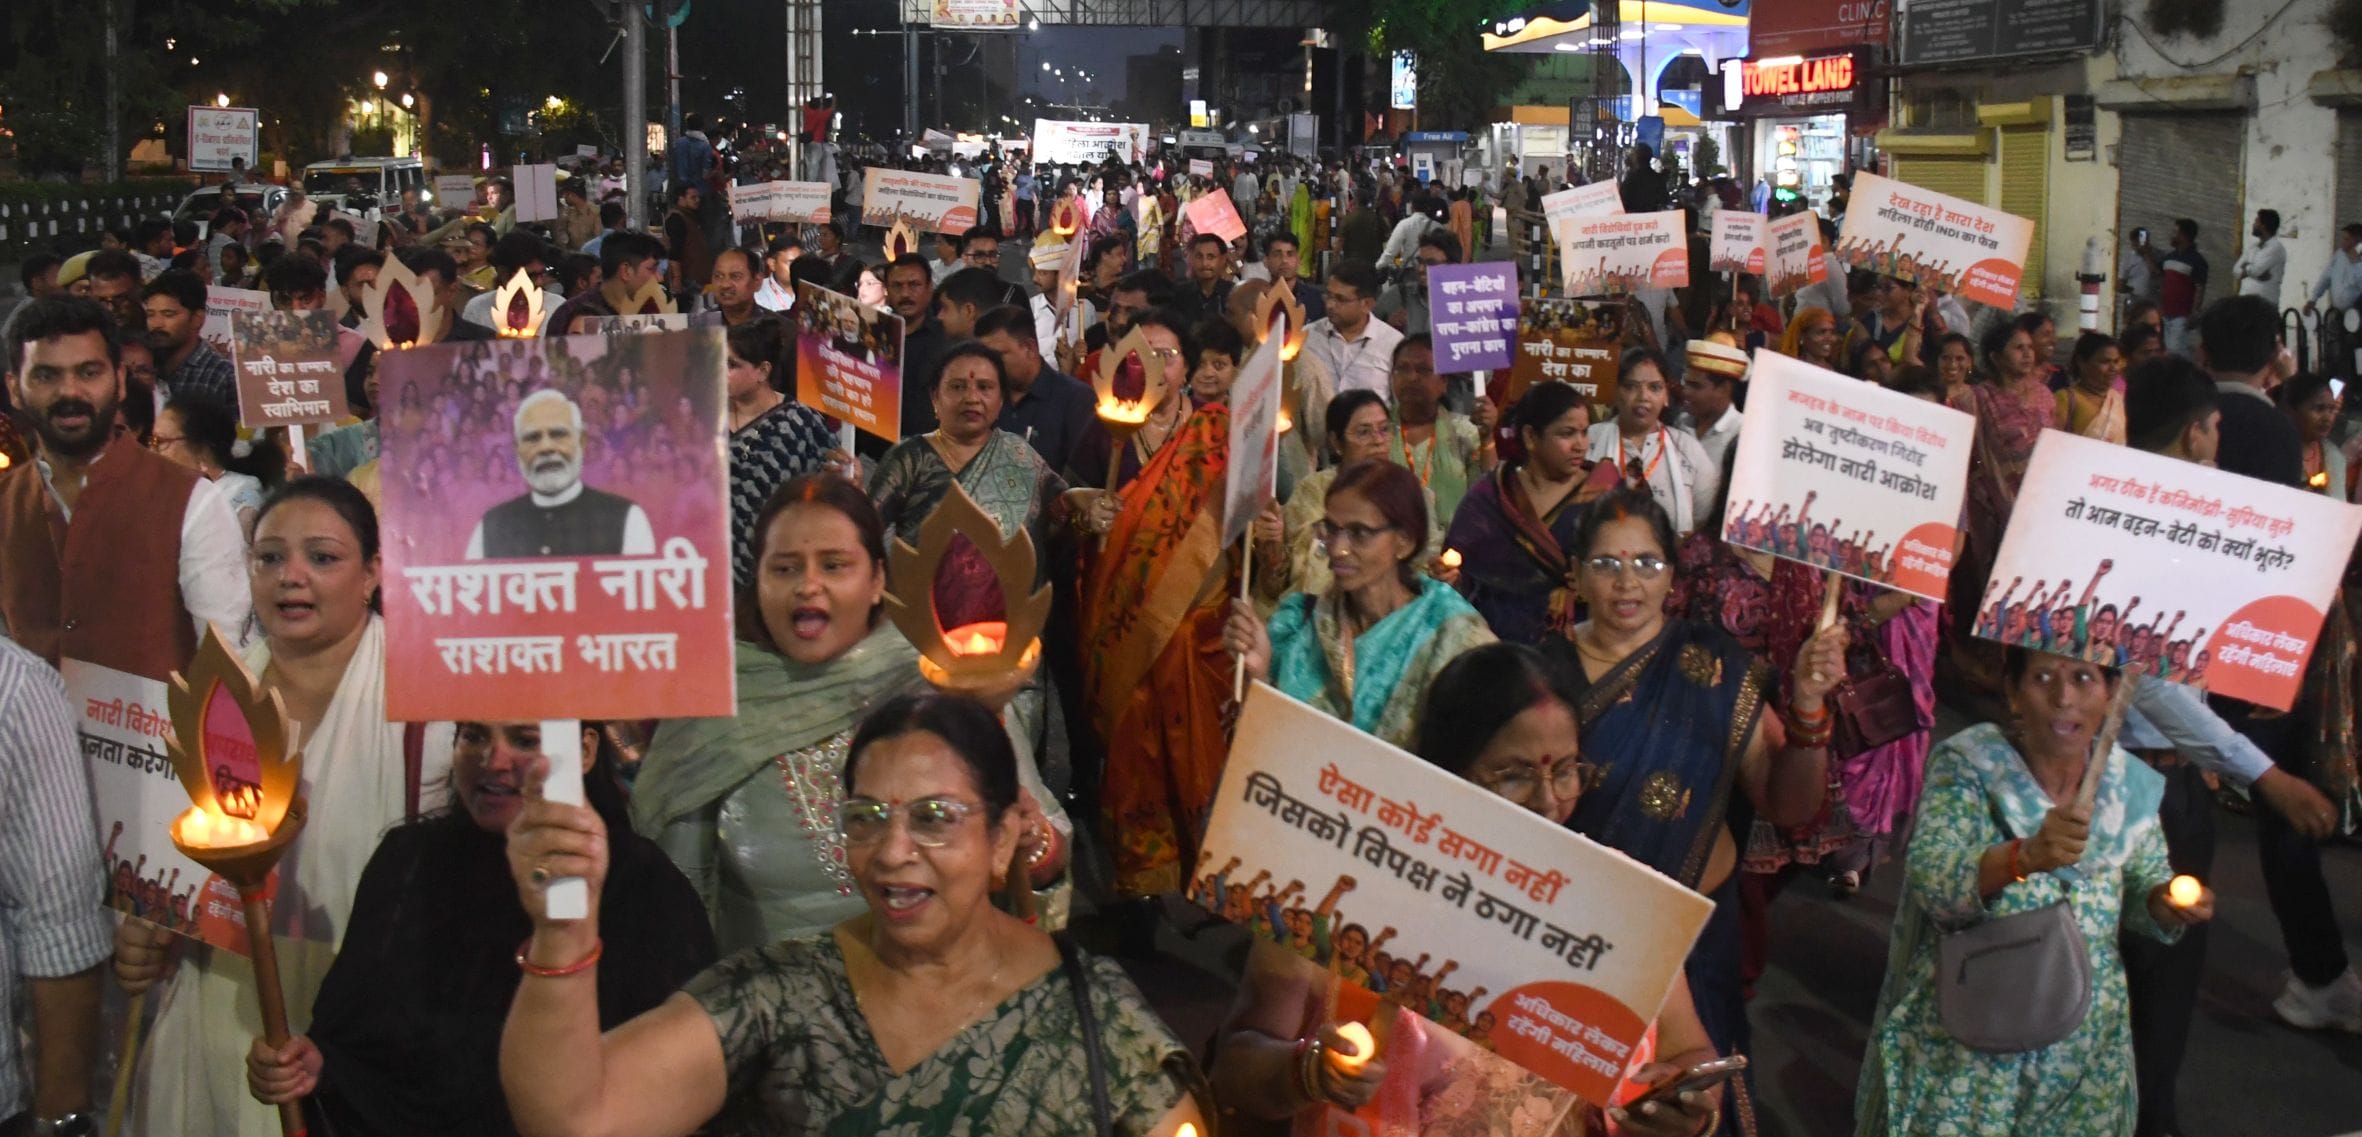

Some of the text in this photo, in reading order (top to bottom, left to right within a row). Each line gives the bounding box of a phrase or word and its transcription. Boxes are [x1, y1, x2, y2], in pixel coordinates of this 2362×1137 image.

[1743, 57, 1853, 96] TOWEL LAND
[1092, 138, 1127, 150] आक्रोश
[1442, 133, 1454, 141] Air
[1878, 207, 1912, 225] महिला
[1936, 225, 1959, 239] INDI
[1961, 231, 1976, 243] का
[1889, 192, 1995, 234] देख रहा है सारा देश
[1572, 238, 1595, 249] अपनी
[1626, 237, 1637, 246] पर
[1654, 232, 1670, 243] करो
[1446, 300, 1503, 314] का अपमान
[1501, 318, 1517, 331] का
[244, 355, 276, 376] नारी
[278, 363, 294, 374] का
[1450, 341, 1481, 361] पुराना
[1523, 338, 1554, 357] नारी
[1556, 346, 1571, 359] का
[1541, 358, 1592, 378] देश का
[267, 377, 320, 396] देश का
[261, 397, 331, 418] स्वाभिमान
[1787, 389, 1948, 449] मजहब के नाम पर किया विरोध
[1803, 416, 1928, 467] अब तुष्टीकरण गिरोह
[1781, 436, 1938, 502] झेलेगा नारी आक्रोश
[2088, 473, 2119, 493] अगर
[2119, 477, 2148, 499] ठीक
[2065, 496, 2295, 573] तो आम बहन-बेटी को क्यों भूले?
[403, 536, 708, 616] सशक्त नारी
[434, 632, 679, 676] सशक्त भारत
[2225, 619, 2308, 655] अधिकार लेकर
[86, 697, 123, 727] नारी
[1317, 761, 1572, 909] ऐसा कोई सगा नहीं
[1243, 770, 1614, 973] जिसको विपक्ष ने ठगा नहीं
[1514, 992, 1630, 1059] अधिकार लेकर
[1508, 1013, 1620, 1078] रहेंगी महिलाएं
